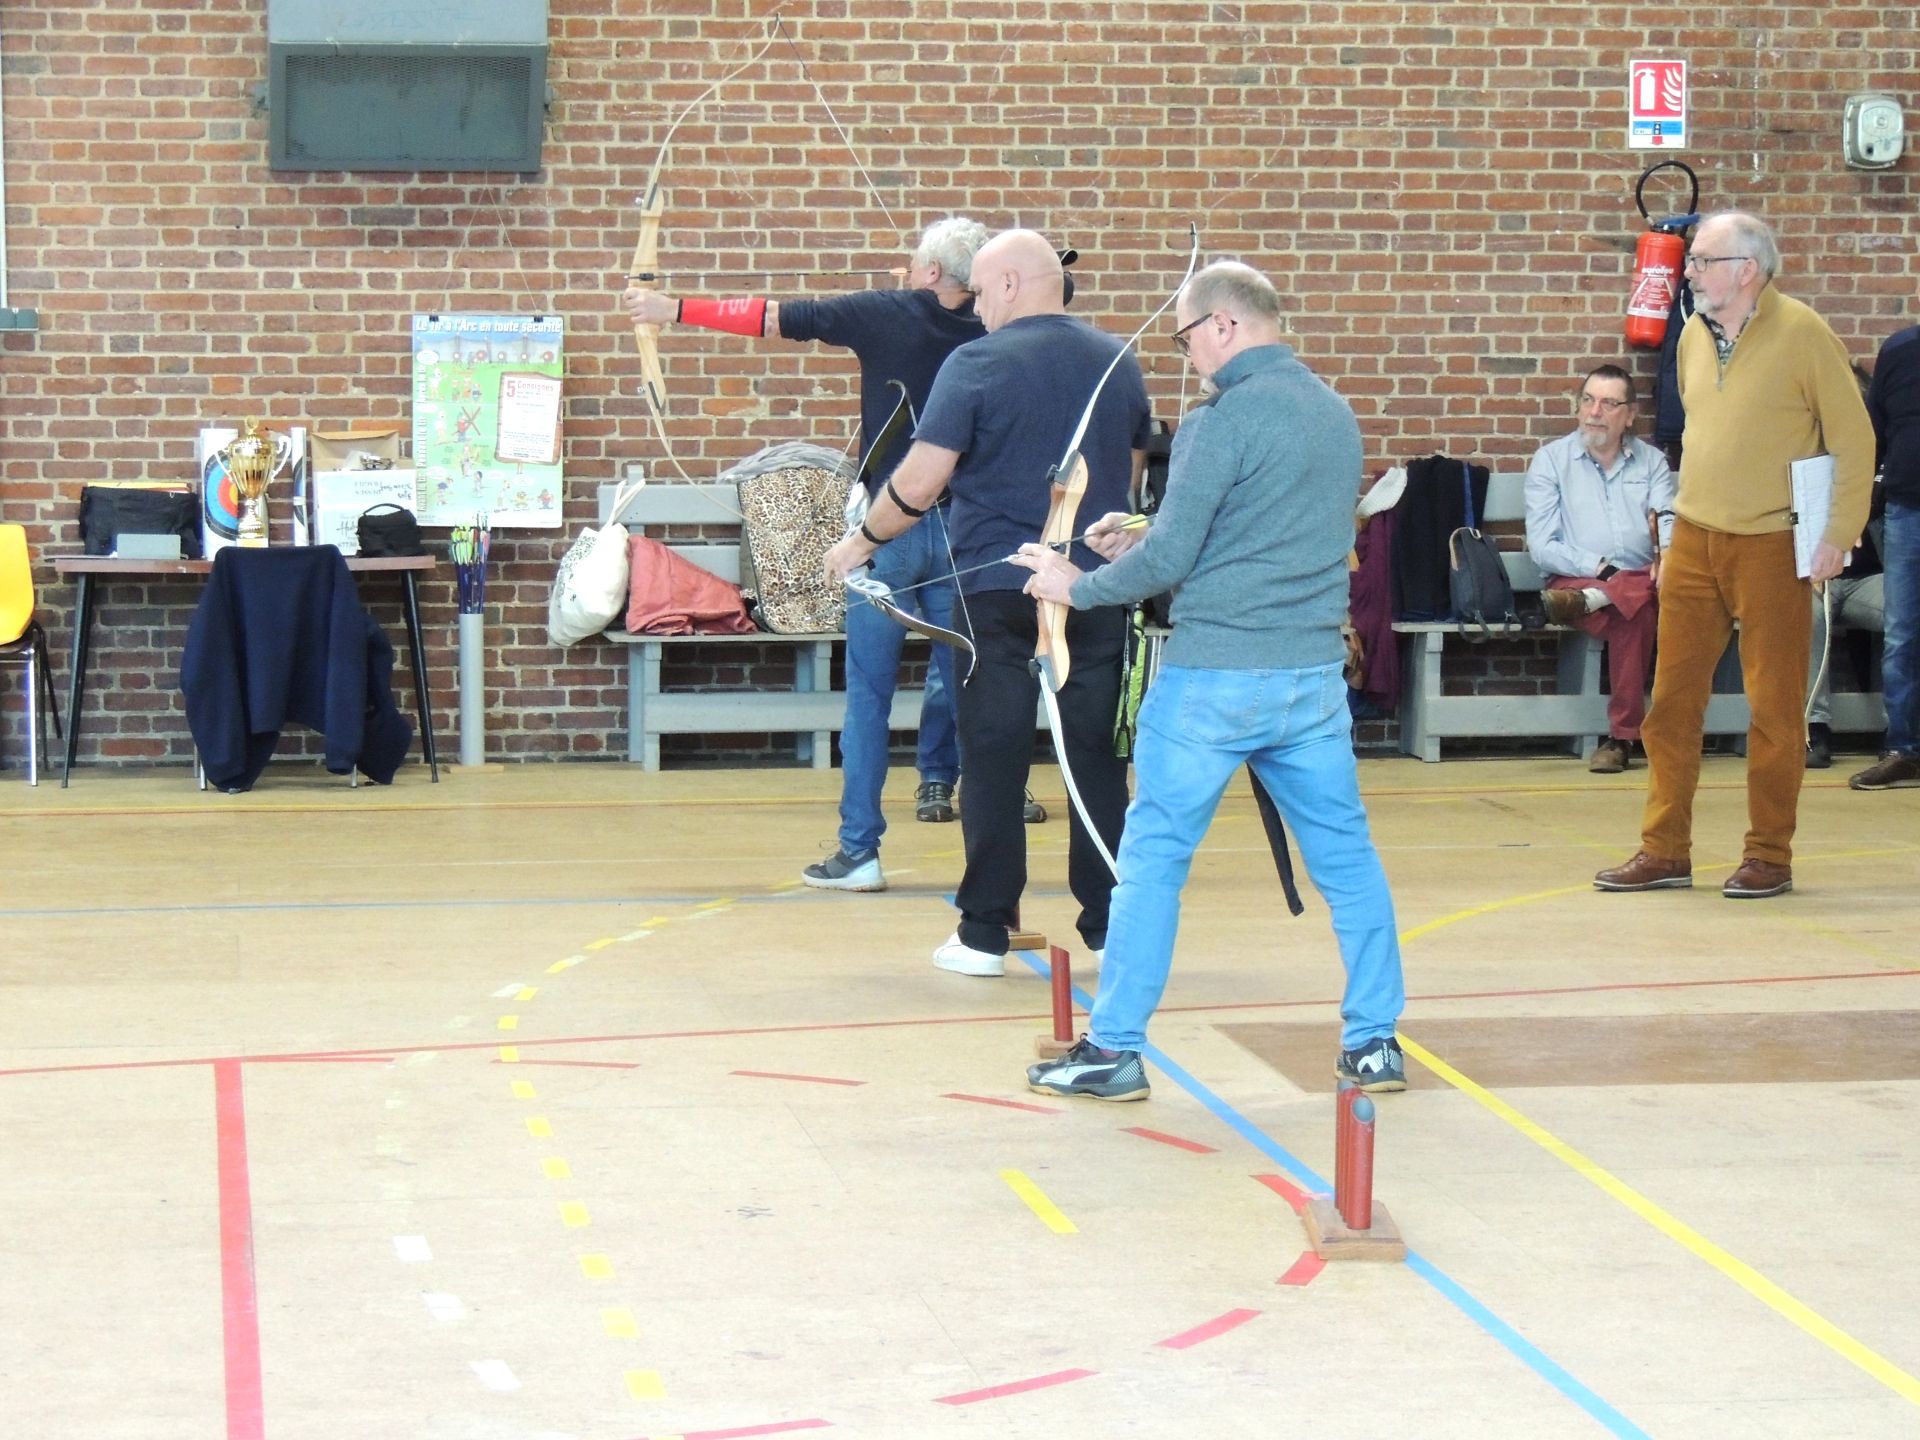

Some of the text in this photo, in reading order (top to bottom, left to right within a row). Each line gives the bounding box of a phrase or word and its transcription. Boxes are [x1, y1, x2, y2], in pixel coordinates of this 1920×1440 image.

[480, 322, 492, 332] en
[494, 320, 519, 332] toute
[506, 380, 516, 397] 5
